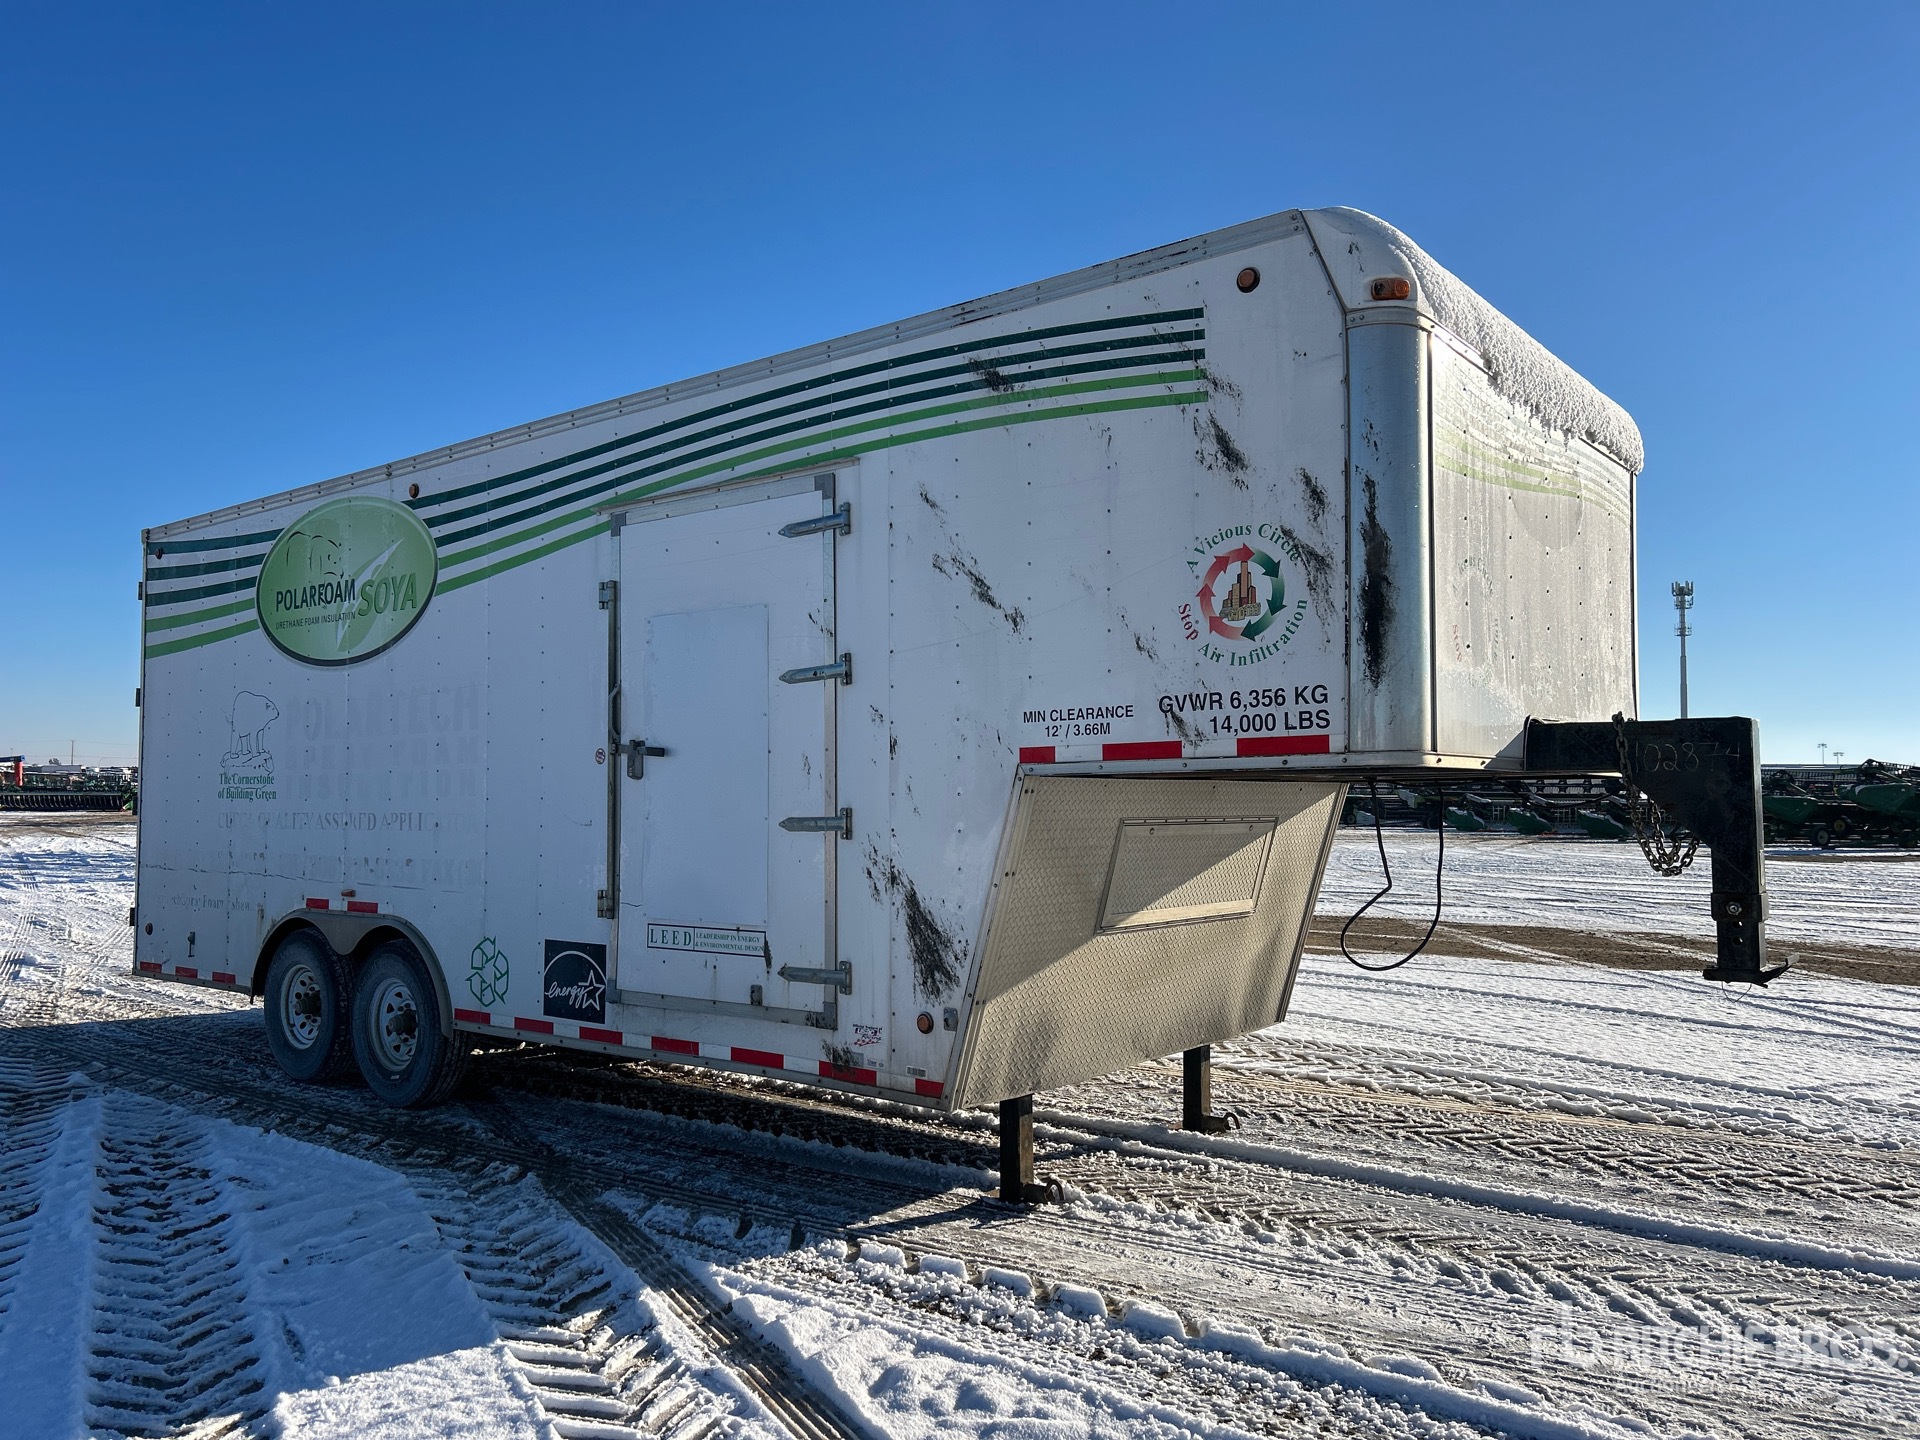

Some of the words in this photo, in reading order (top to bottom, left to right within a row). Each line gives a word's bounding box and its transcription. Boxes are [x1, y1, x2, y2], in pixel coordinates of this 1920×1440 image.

[1187, 560, 1199, 573] A
[1194, 524, 1252, 555] Vicious
[276, 579, 356, 612] POLARFOAM
[358, 572, 417, 616] SOYA
[275, 618, 304, 630] URETHANE
[304, 617, 320, 626] FOAM
[321, 611, 356, 624] INSULATION
[1178, 603, 1199, 641] Stop
[1198, 643, 1224, 663] Air
[1229, 600, 1308, 667] Infiltration
[1159, 692, 1223, 714] GVWR
[1230, 687, 1287, 712] 6,356
[1294, 685, 1329, 705] KG
[1023, 711, 1046, 724] MIN
[1050, 705, 1134, 722] CLEARANCE
[1209, 713, 1277, 735] 14,000
[1284, 709, 1331, 731] LBS
[1045, 725, 1062, 738] 12'
[1073, 722, 1111, 736] 3.66M
[219, 772, 231, 784] The
[232, 773, 274, 784] Cornerstone
[218, 787, 225, 799] of
[226, 787, 253, 802] Building
[255, 787, 277, 800] Green
[258, 812, 314, 832] QUALITY
[316, 812, 377, 832] ASSURED
[650, 928, 692, 947] LEED
[696, 932, 729, 941] LEADERSHIP
[737, 935, 760, 943] ENERGY
